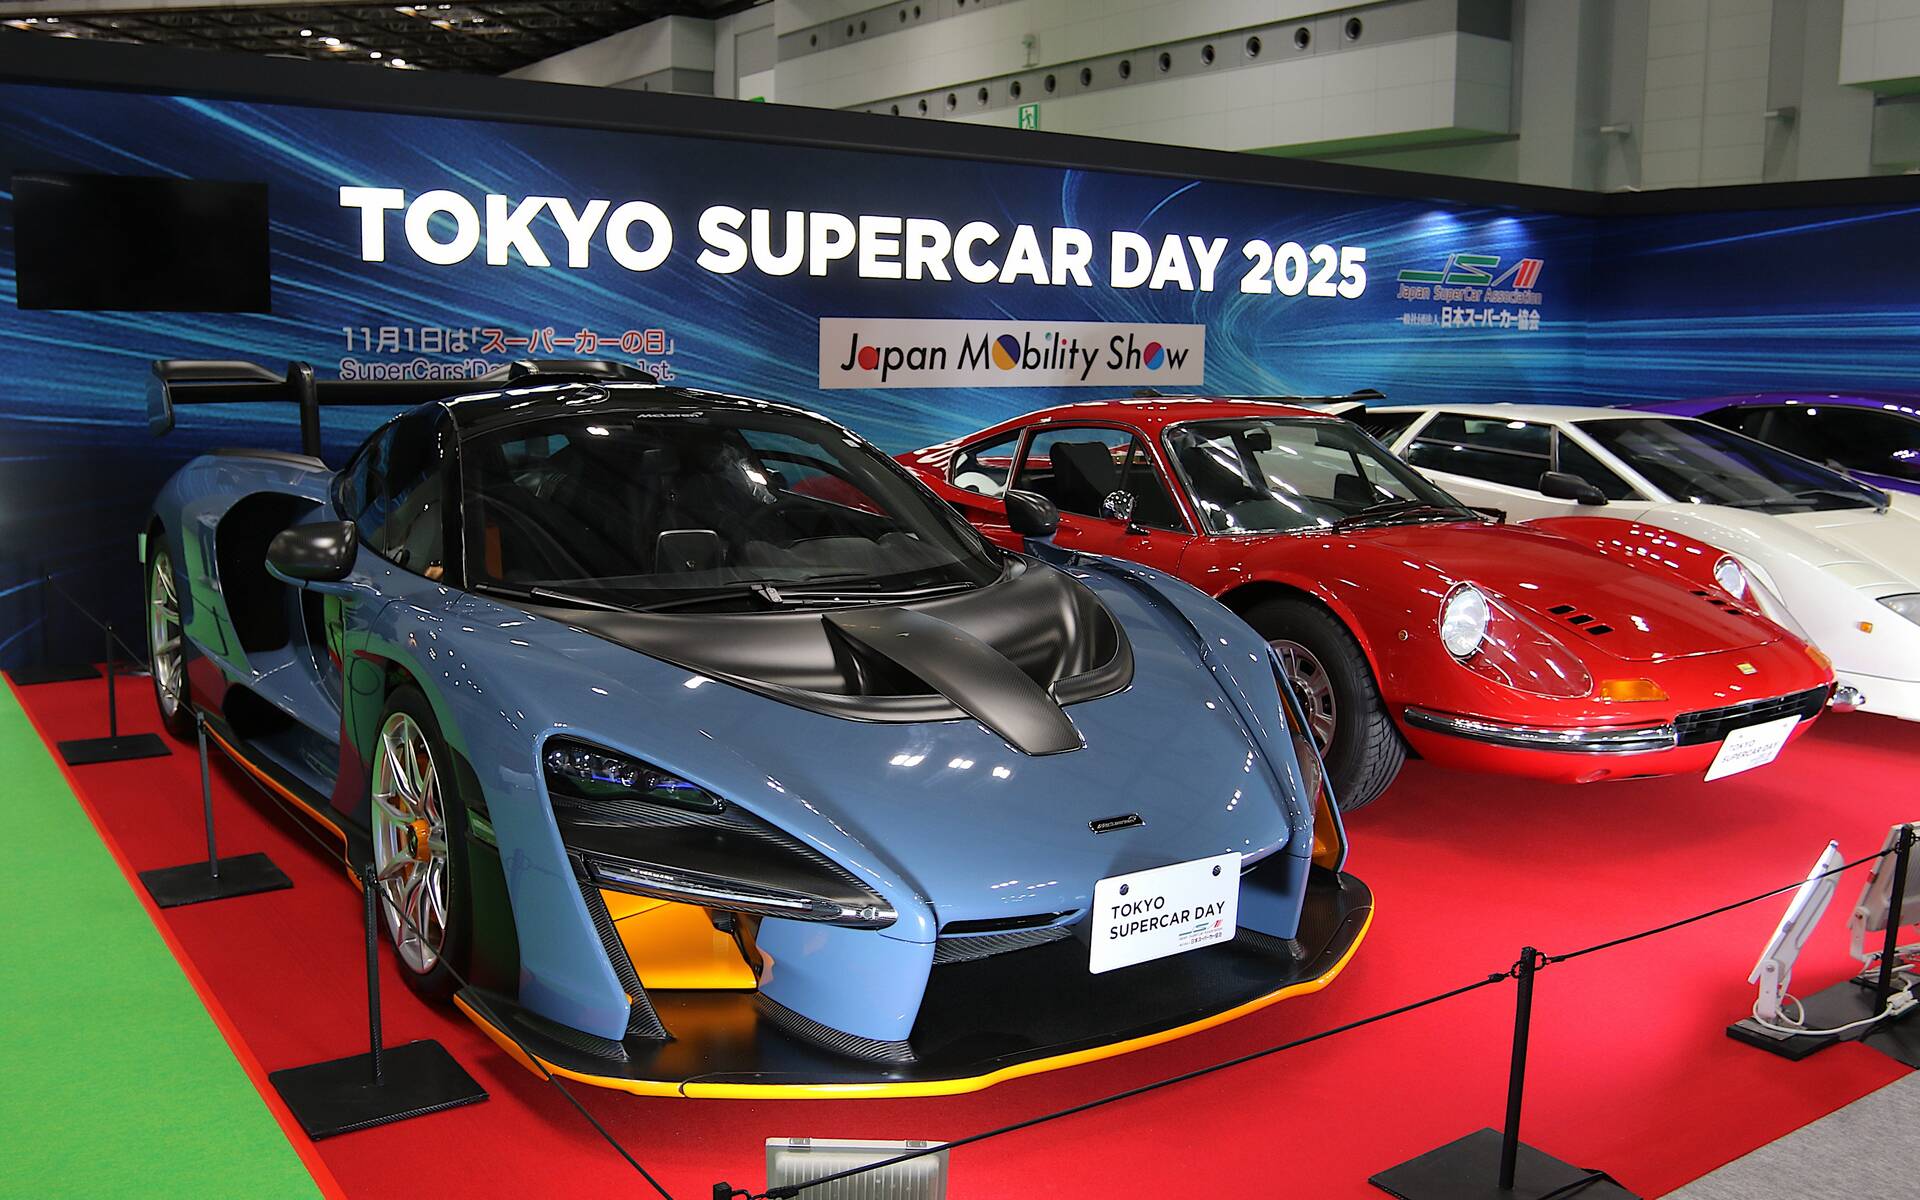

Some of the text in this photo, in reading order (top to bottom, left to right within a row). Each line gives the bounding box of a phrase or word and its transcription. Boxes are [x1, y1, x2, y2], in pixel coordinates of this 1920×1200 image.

[339, 186, 1367, 299] TOKYO SUPERCAR DAY 2025
[1397, 283, 1543, 305] Japan SuperCar Association
[342, 327, 675, 355] 11月1日は「スーパーカーの日」
[840, 332, 1190, 382] Japan Mobility Show
[1110, 910, 1190, 940] SUPERCAR
[1195, 901, 1225, 920] DAY
[1111, 896, 1165, 919] TOKYO
